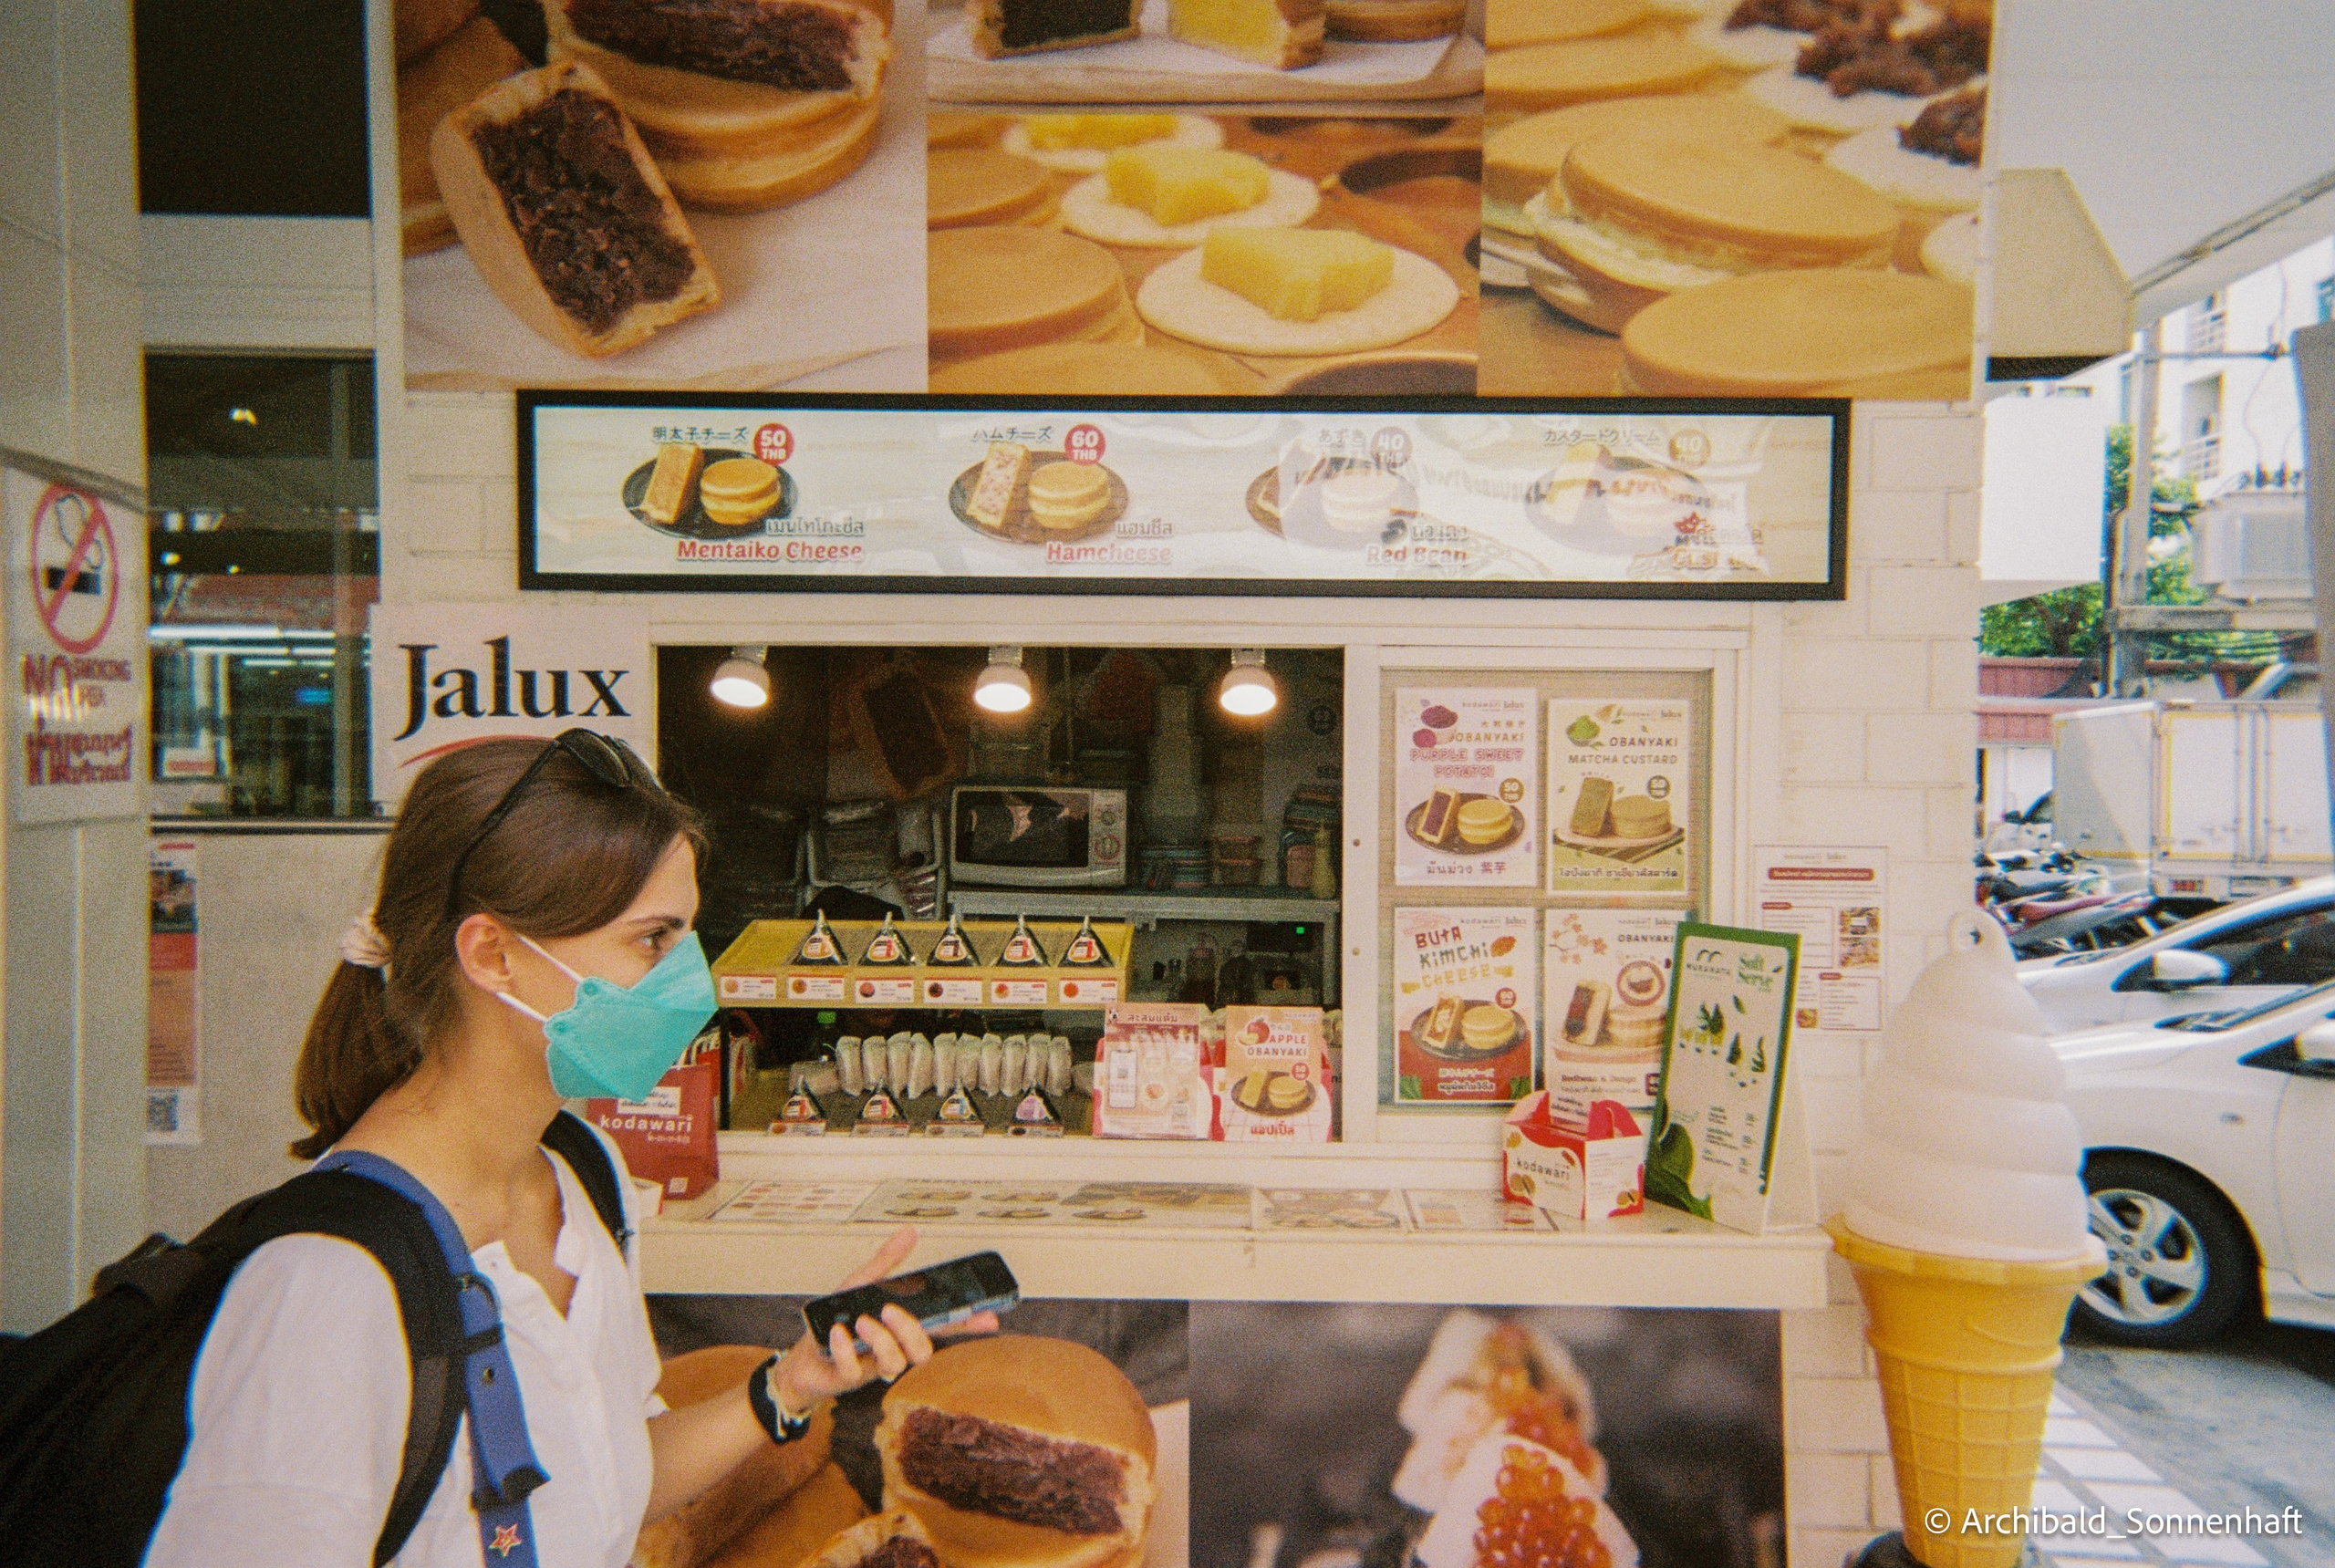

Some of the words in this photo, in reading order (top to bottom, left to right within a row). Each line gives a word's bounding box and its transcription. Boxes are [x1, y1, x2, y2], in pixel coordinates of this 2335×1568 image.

[652, 426, 749, 441] 明太子チーズ
[761, 430, 787, 447] 50
[972, 426, 1053, 441] ハムチーズ
[1071, 431, 1099, 448] 60
[1378, 433, 1406, 449] 40
[762, 448, 787, 460] THB
[1072, 449, 1097, 461] THB
[678, 540, 780, 559] Mentaiko
[786, 541, 864, 560] Cheese
[1048, 543, 1172, 562] Hamcheese
[1368, 545, 1407, 562] Red
[393, 636, 632, 742] Jalux
[1455, 732, 1524, 742] OBANYAKI
[1609, 736, 1678, 747] OBANYAKI
[1410, 748, 1468, 761] PURPLE
[1475, 748, 1524, 761] SWEET
[1568, 754, 1618, 764] MATCHA
[1623, 754, 1678, 764] CUSTARD
[1617, 934, 1675, 943] OBANYAKI
[1422, 963, 1490, 989] CHEESE
[1269, 1034, 1306, 1044] APPLE
[1247, 1047, 1307, 1056] OBANYAKI
[600, 1115, 692, 1132] kodawari
[1516, 1157, 1571, 1181] kodawari
